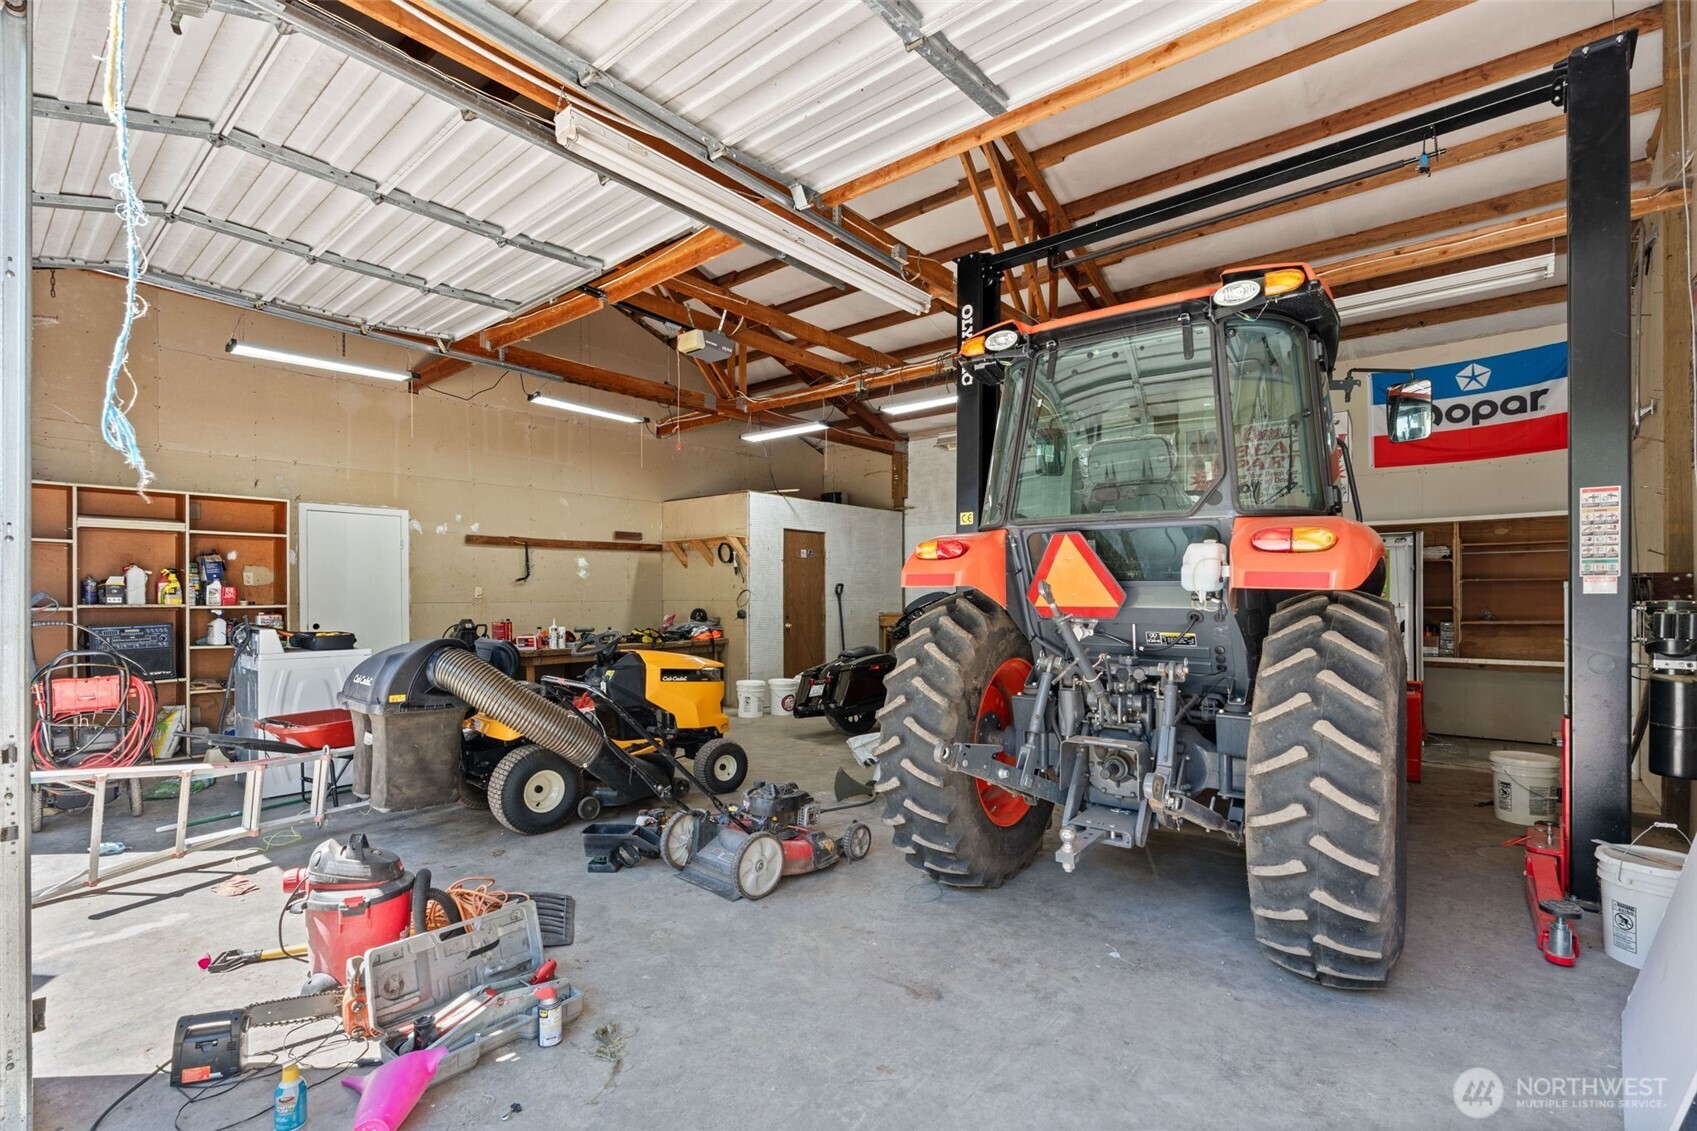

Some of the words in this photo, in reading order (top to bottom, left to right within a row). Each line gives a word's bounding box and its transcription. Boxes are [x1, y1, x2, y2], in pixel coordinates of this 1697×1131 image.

[1235, 441, 1299, 458] BEAC
[1236, 453, 1300, 471] PART
[961, 513, 972, 523] CE
